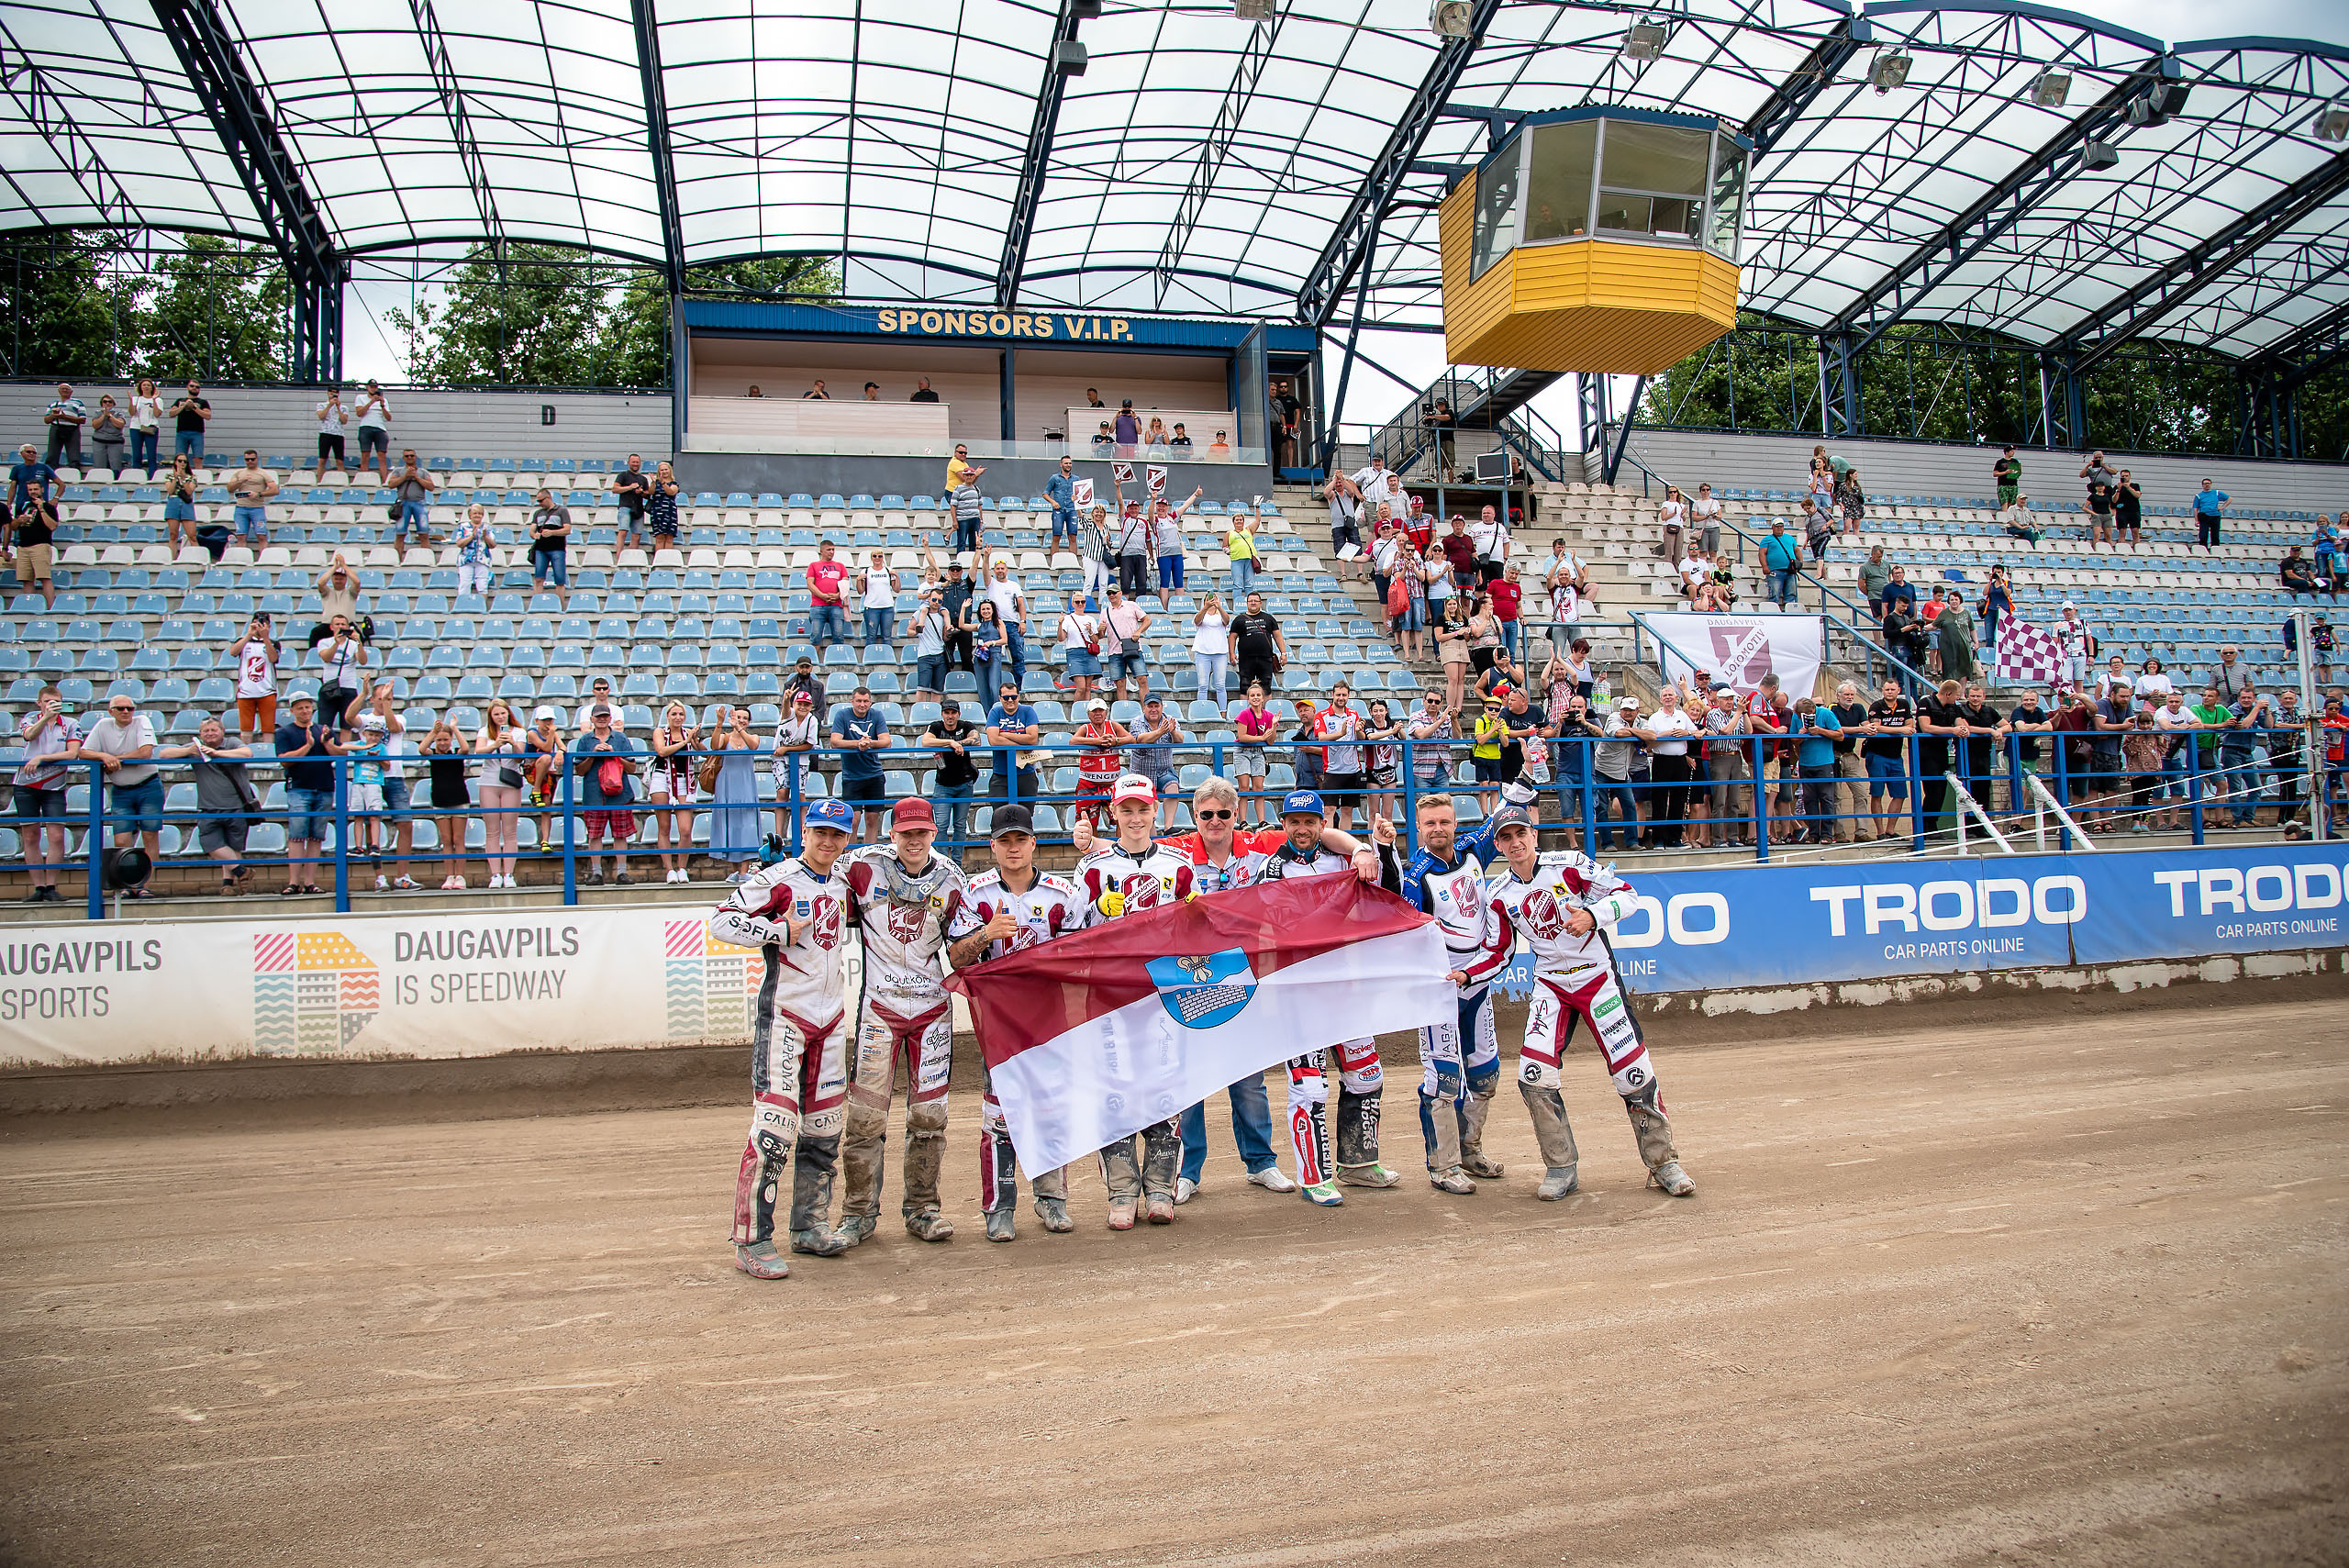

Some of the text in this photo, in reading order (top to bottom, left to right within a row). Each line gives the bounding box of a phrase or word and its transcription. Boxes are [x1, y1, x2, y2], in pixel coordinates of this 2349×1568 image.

[877, 309, 1134, 340] SPONSORS V.I.P.
[541, 405, 556, 426] D
[1707, 617, 1765, 627] DAUGAVPILS
[1724, 628, 1766, 678] LOOMOTIV
[1099, 758, 1107, 771] 1
[976, 873, 996, 884] SELS
[1055, 880, 1073, 895] SELS
[2153, 863, 2349, 917] TROD
[1125, 879, 1155, 905] LOKOMOTIV
[1809, 874, 2087, 937] TRODO
[729, 916, 781, 943] SOFIA
[2216, 917, 2338, 939] CAR PARTS ONLINE
[395, 926, 580, 962] DAUGAVPILS
[1884, 937, 2024, 960] CAR PARTS ONLINE
[0, 940, 162, 975] UGAVPILS
[1618, 960, 1657, 976] LINE
[395, 969, 567, 1006] IS SPEEDWAY
[1597, 998, 1620, 1016] G-STOCK
